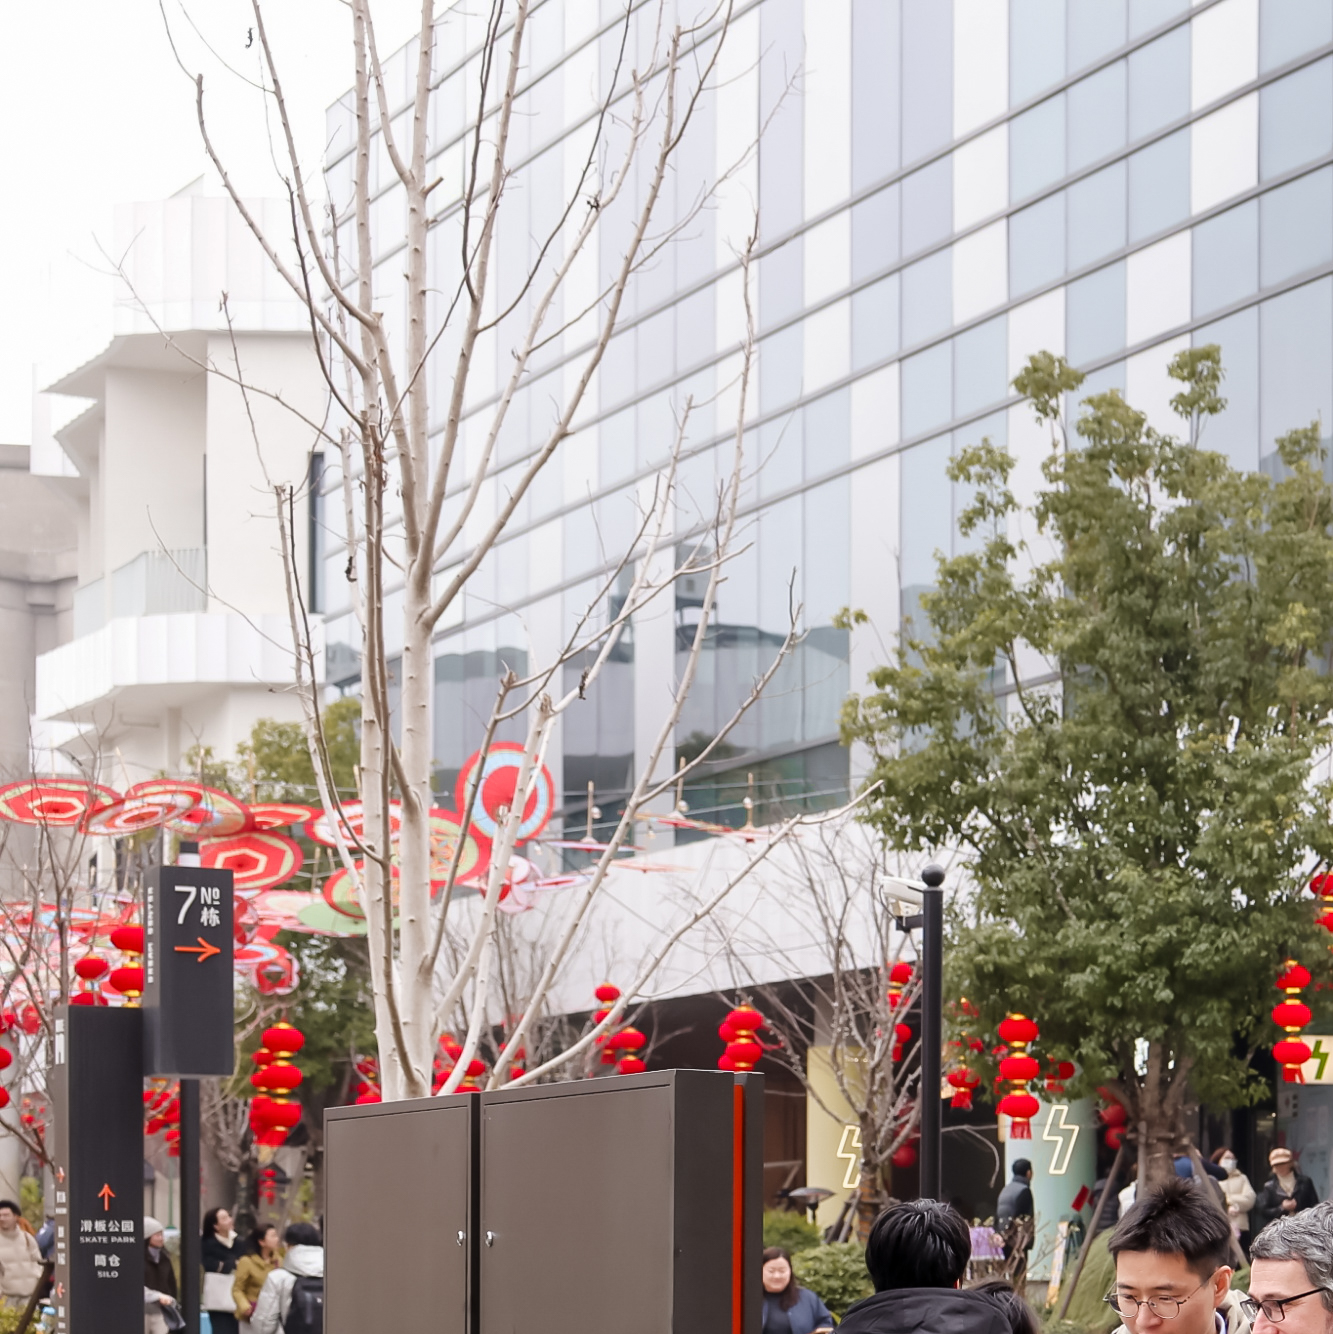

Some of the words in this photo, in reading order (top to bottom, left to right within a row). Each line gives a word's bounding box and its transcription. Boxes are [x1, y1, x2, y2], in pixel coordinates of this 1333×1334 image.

[174, 885, 197, 924] 7
[200, 907, 220, 927] 栋
[80, 1219, 134, 1233] 滑板公园
[97, 1270, 119, 1278] SILO
